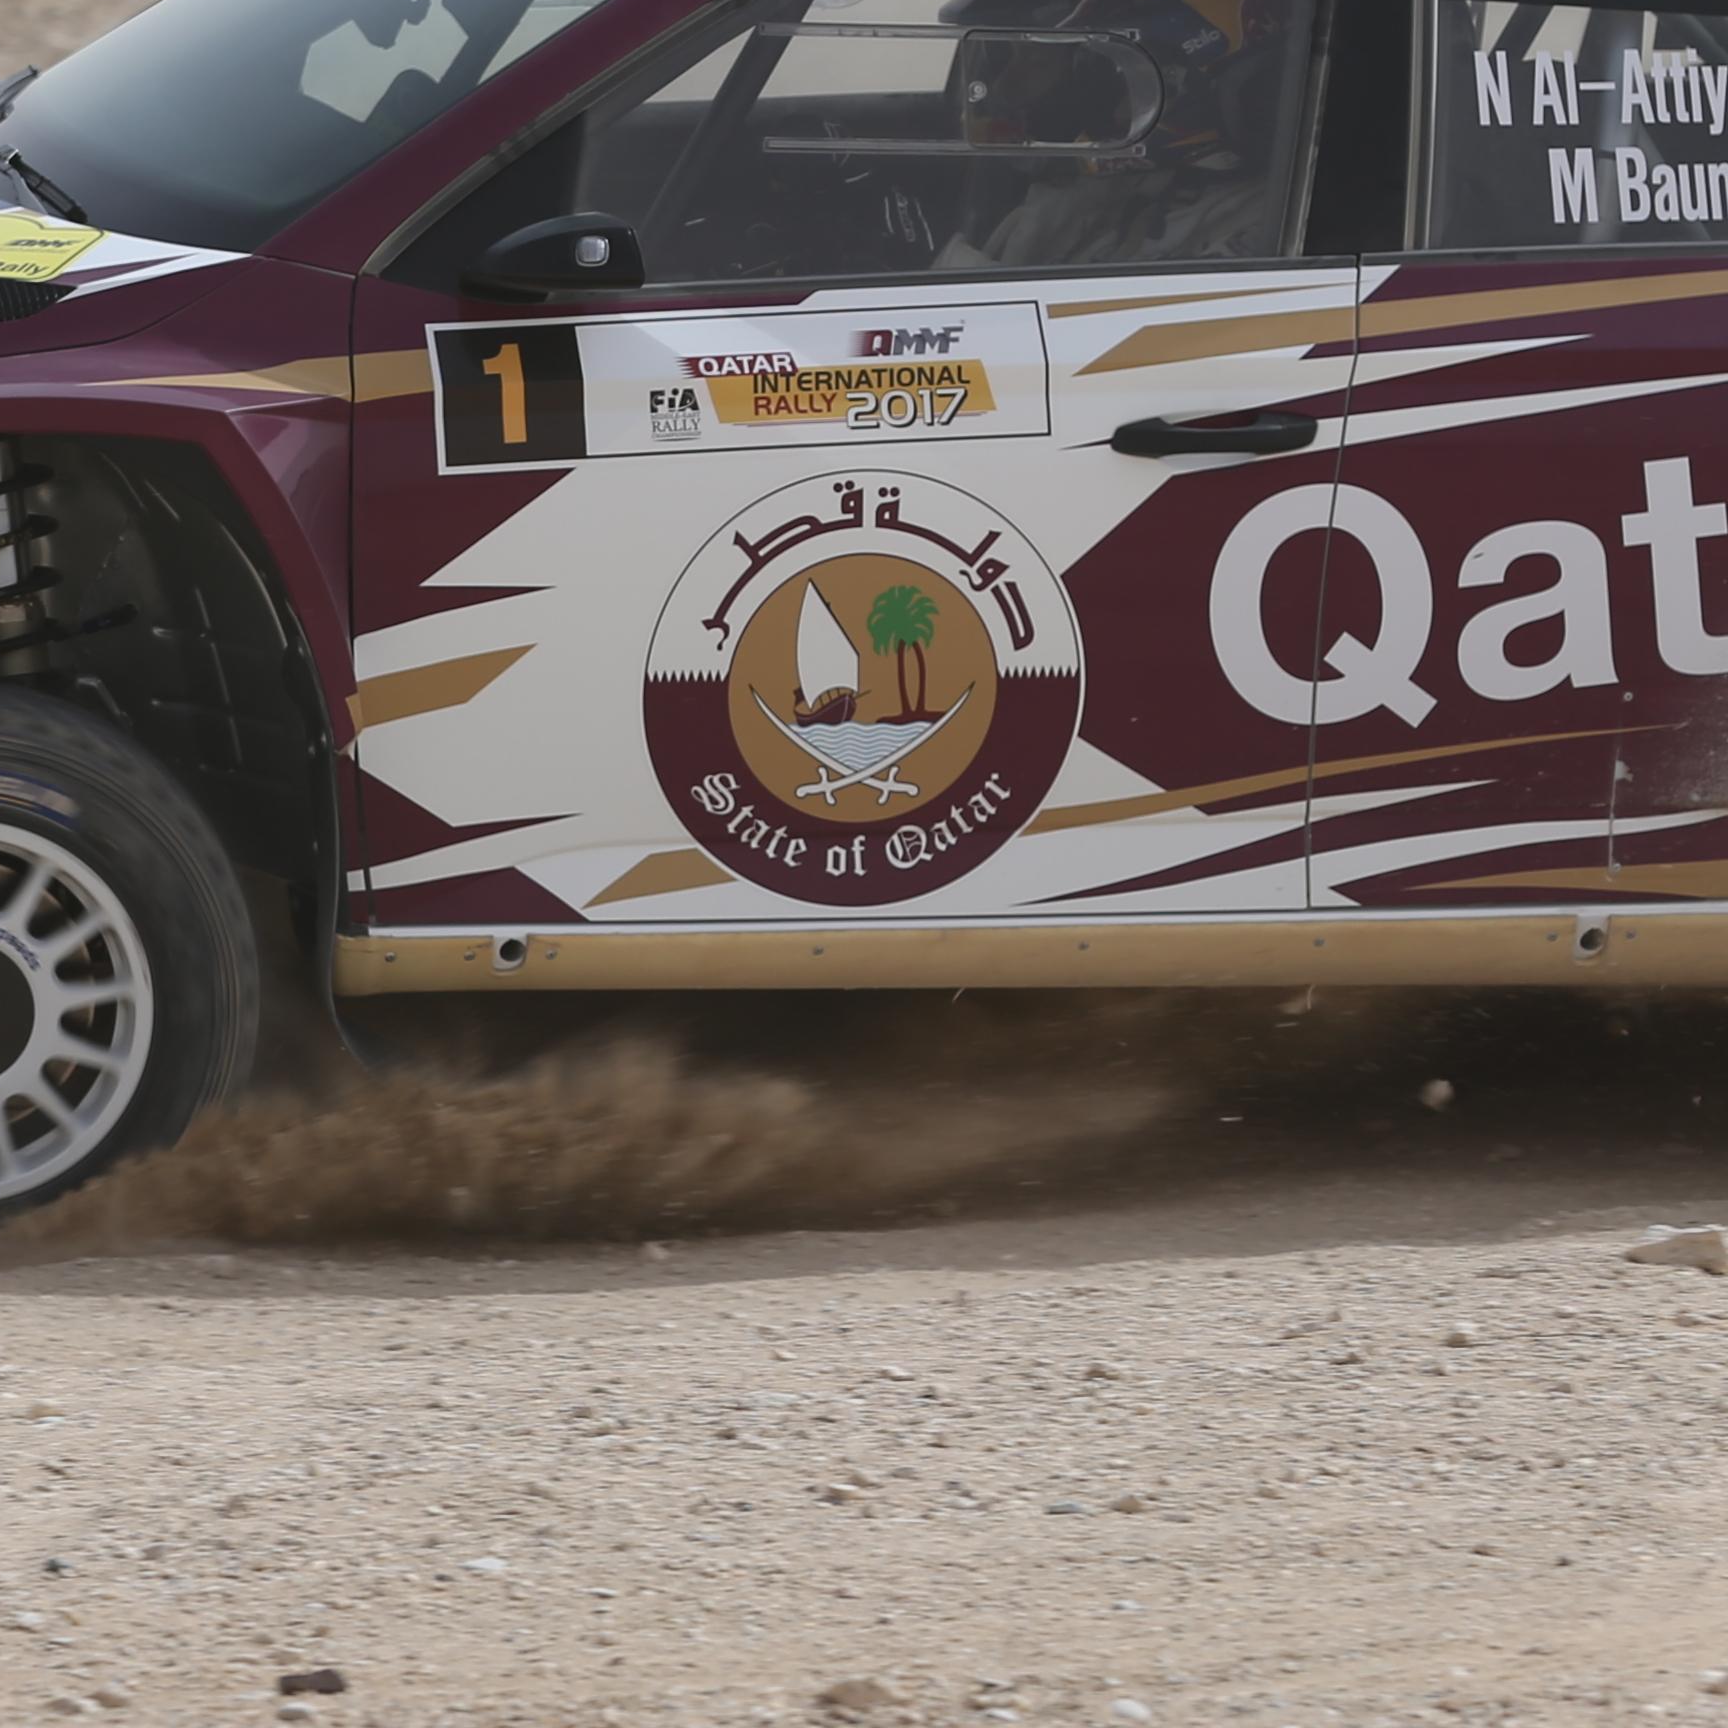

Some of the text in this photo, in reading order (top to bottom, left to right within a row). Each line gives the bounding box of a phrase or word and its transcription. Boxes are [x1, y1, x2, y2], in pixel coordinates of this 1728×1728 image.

[1474, 50, 1513, 126] N
[1548, 147, 1600, 224] M
[698, 353, 794, 376] QATAR
[864, 326, 965, 357] QMMF
[482, 343, 527, 444] 1
[753, 365, 971, 394] INTERNATIONAL
[754, 387, 969, 429] RALLY 2017
[652, 418, 702, 432] RALLY
[701, 480, 1035, 651] دولة قطر
[690, 771, 1012, 877] State of Qatar
